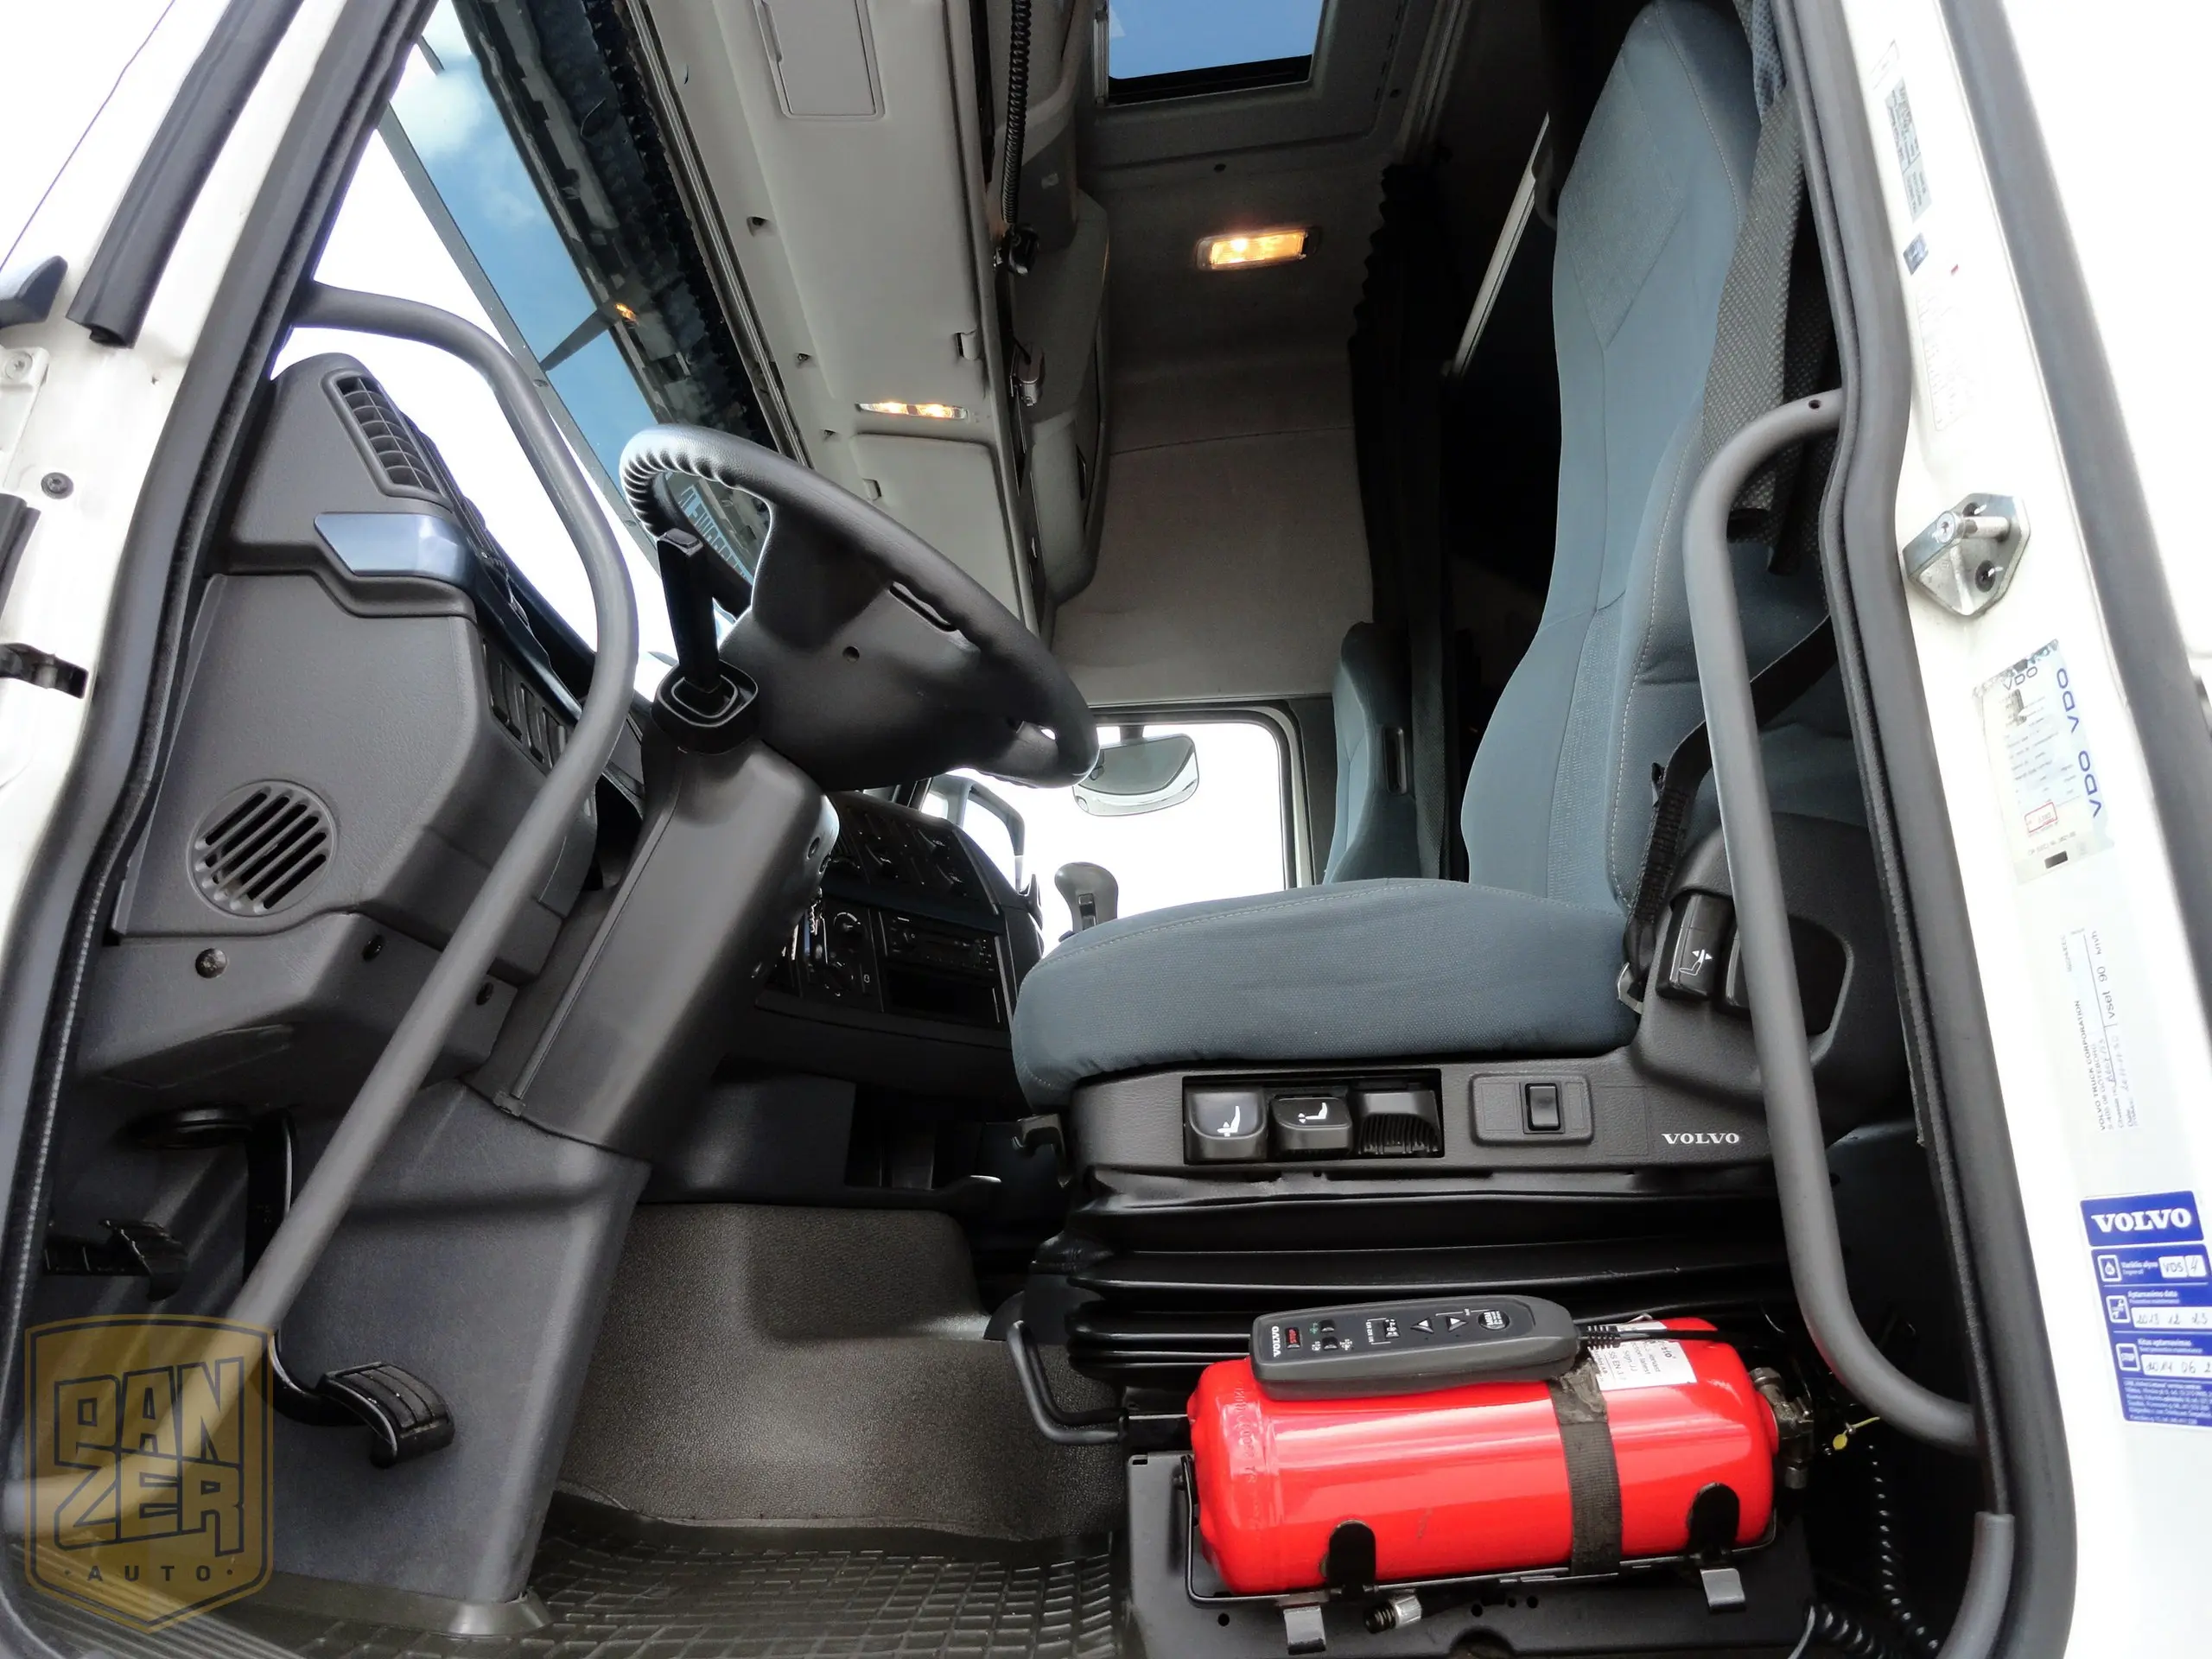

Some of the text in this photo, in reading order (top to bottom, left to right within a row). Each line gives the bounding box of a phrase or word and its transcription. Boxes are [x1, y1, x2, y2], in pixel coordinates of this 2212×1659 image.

[2002, 666, 2038, 690] VDO
[2056, 668, 2102, 818] VDO VDO
[2096, 966, 2108, 982] 90
[1661, 1132, 1740, 1145] VOLVO
[2091, 1207, 2192, 1233] VOLVO
[1271, 1325, 1281, 1357] VOLVO
